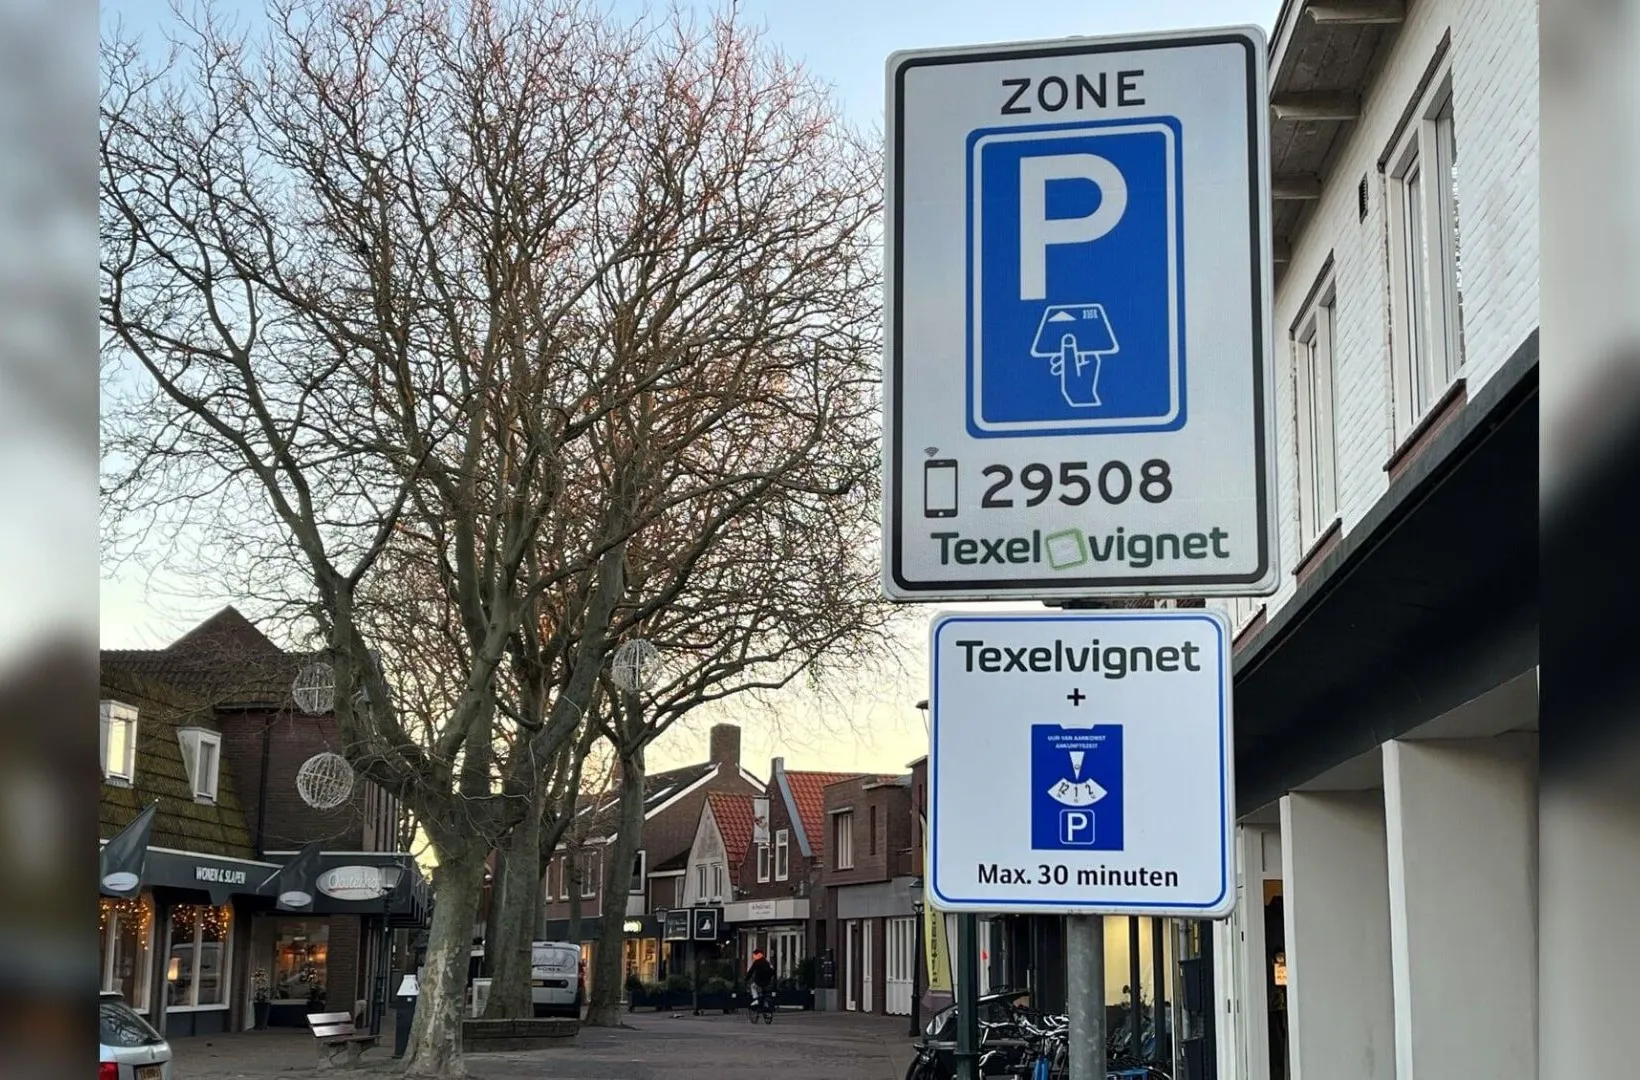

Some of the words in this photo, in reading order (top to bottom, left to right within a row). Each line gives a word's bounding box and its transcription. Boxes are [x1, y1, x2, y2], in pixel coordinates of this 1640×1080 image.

[1001, 69, 1146, 115] ZONE
[1020, 153, 1128, 301] P
[981, 458, 1173, 509] 29508
[956, 639, 1200, 679] Texelvignet
[1068, 812, 1088, 842] P
[978, 863, 1032, 886] Max.
[1037, 864, 1069, 886] 30
[1077, 864, 1178, 887] minuten
